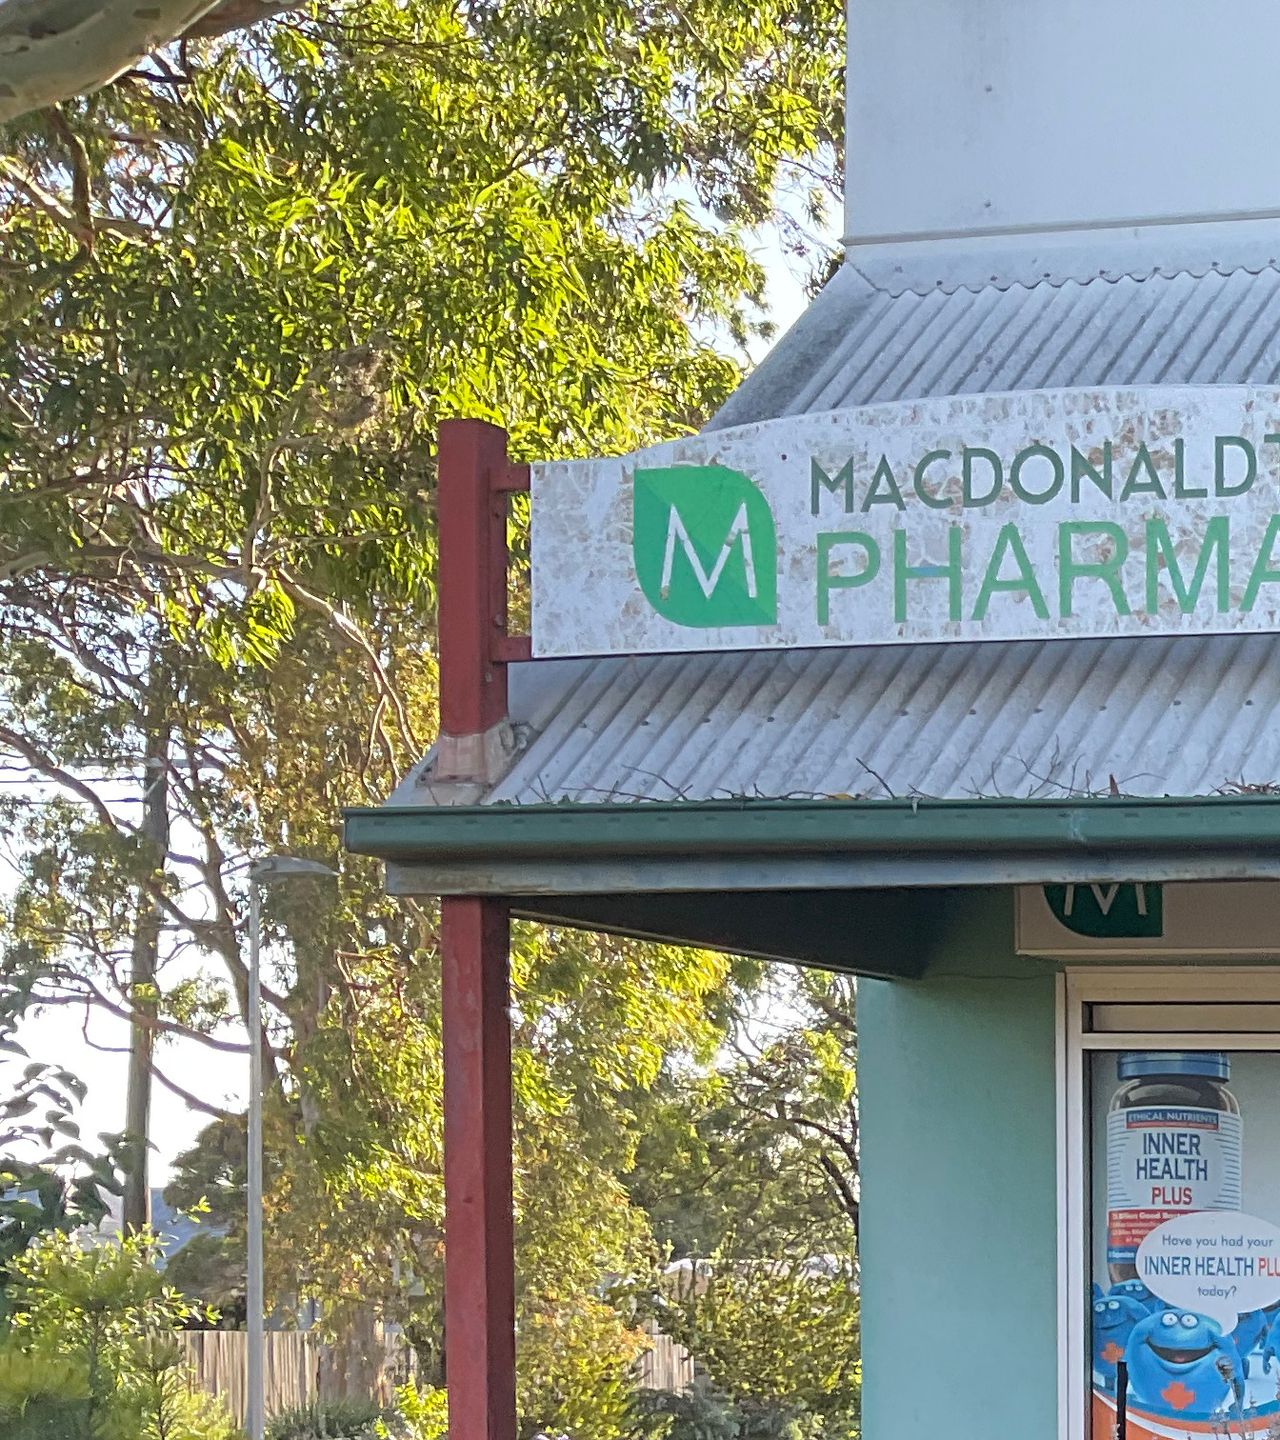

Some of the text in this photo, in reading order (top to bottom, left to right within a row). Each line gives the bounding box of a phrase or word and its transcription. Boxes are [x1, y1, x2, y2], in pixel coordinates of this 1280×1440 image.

[660, 500, 758, 600] M
[1143, 1132, 1202, 1156] INNER
[1136, 1158, 1208, 1181] HEALTH
[1151, 1187, 1193, 1206] PLUS
[1162, 1234, 1274, 1249] Have you had your
[1144, 1255, 1192, 1276] INNER
[1195, 1256, 1255, 1277] HEALTH
[1198, 1285, 1238, 1299] today?
